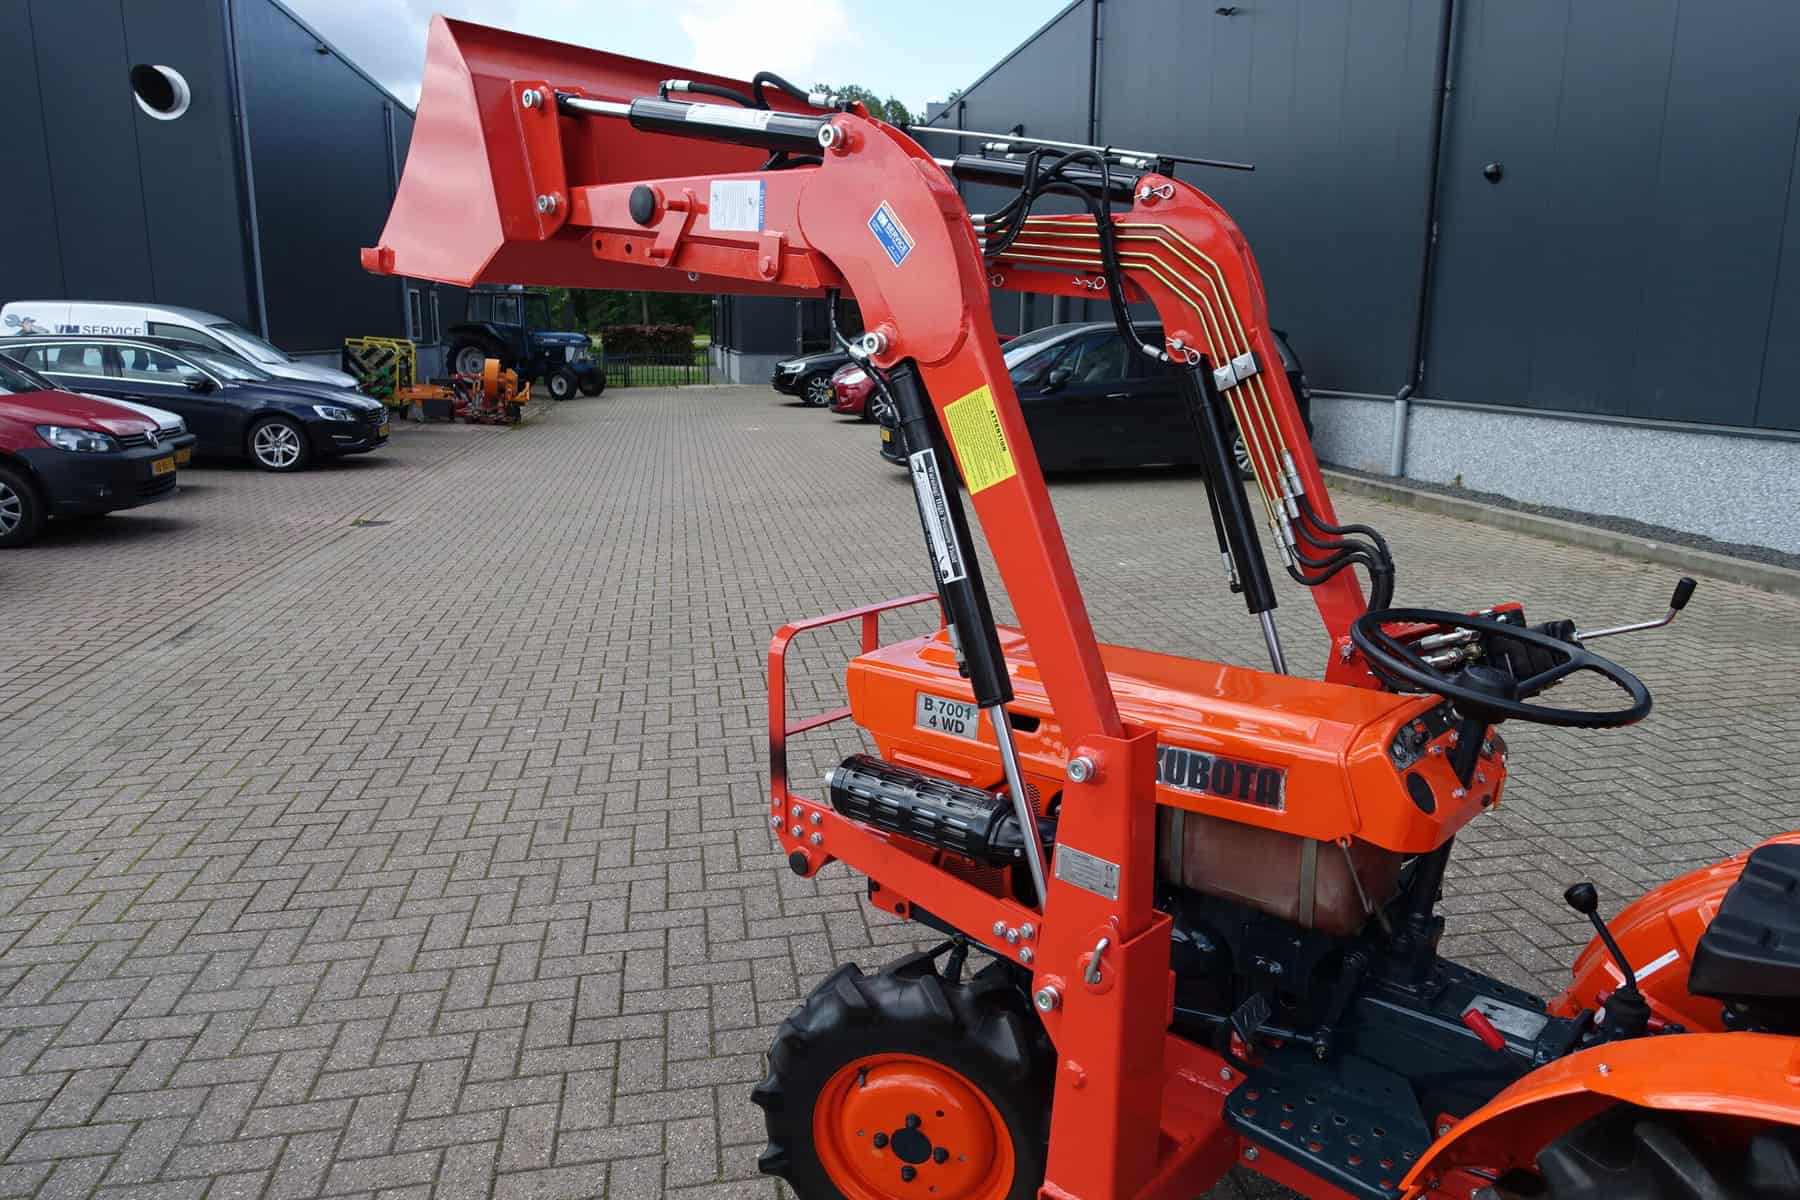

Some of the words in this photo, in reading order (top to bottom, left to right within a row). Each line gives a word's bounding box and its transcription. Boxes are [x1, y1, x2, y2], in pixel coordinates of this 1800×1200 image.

[82, 324, 142, 335] SERVICE
[989, 409, 1008, 452] ATTENTION
[924, 697, 934, 711] B
[938, 700, 971, 720] 7001
[928, 715, 937, 728] 4
[941, 716, 965, 733] WD
